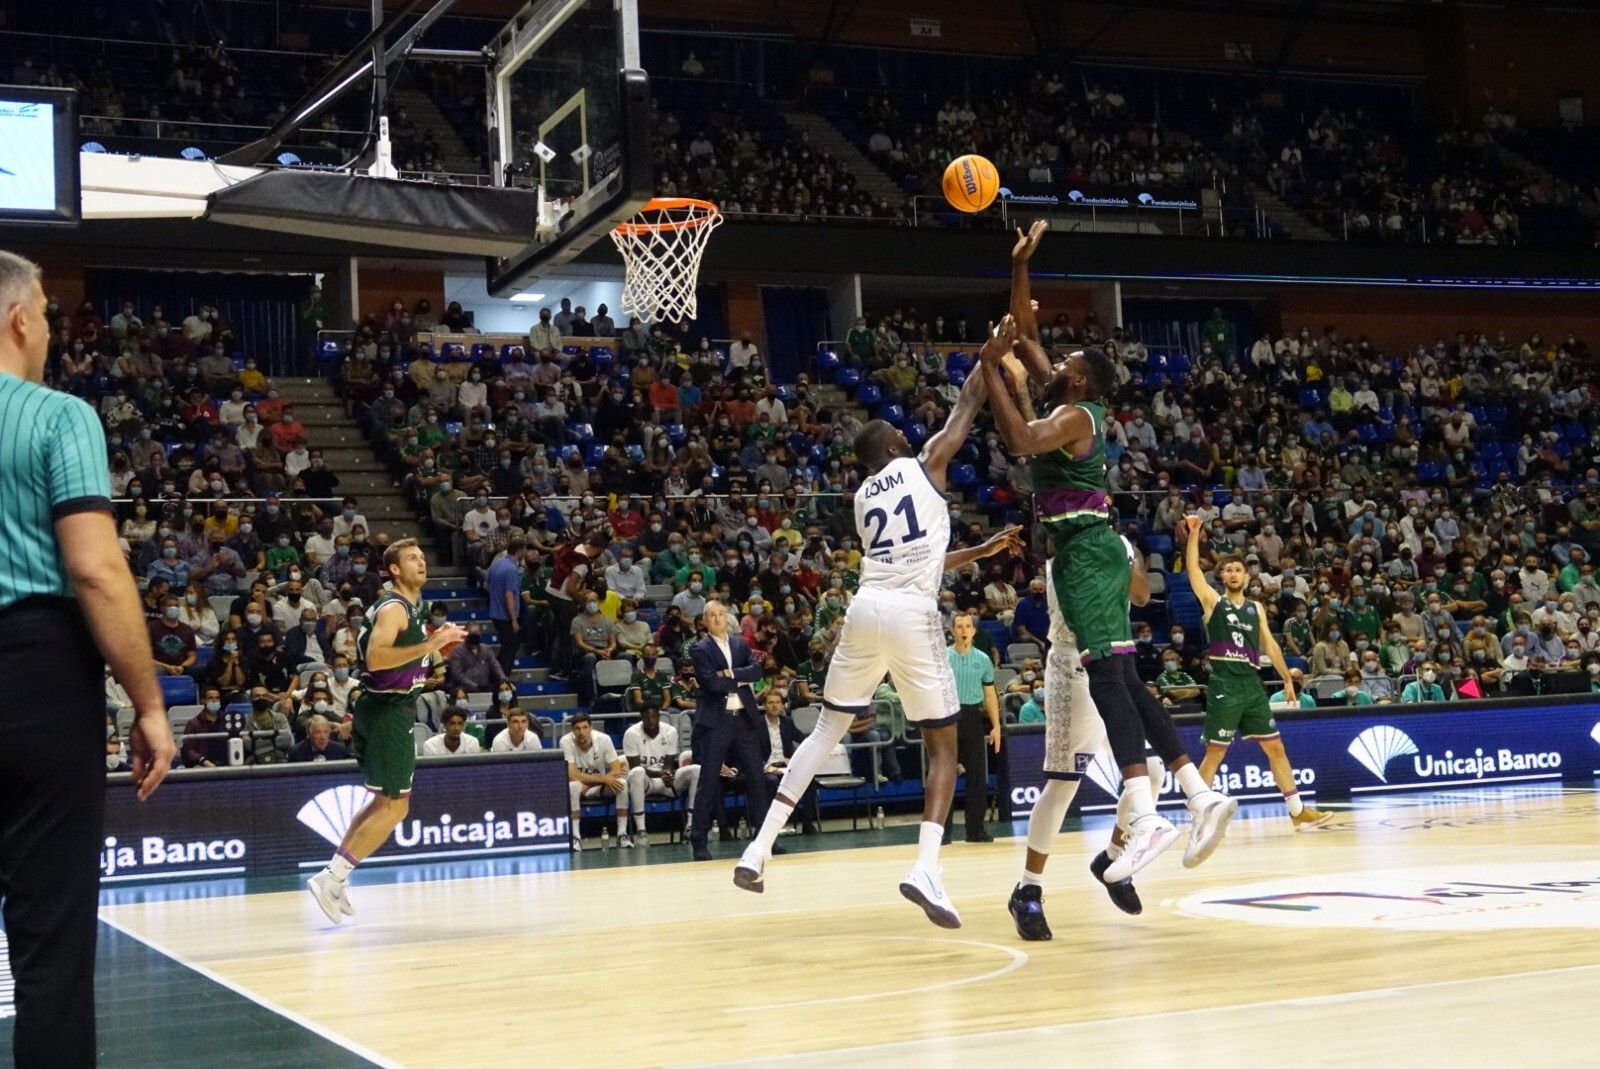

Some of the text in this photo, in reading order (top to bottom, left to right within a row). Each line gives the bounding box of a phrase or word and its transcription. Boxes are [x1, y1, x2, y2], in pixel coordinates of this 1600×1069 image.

[962, 159, 978, 195] Wilson
[864, 471, 905, 500] LOUM
[863, 494, 928, 550] 21
[1244, 764, 1316, 789] Baco
[1413, 747, 1562, 779] Unicaja Banco
[1010, 786, 1041, 805] co
[394, 810, 514, 848] Unicaja
[142, 836, 246, 865] Banco
